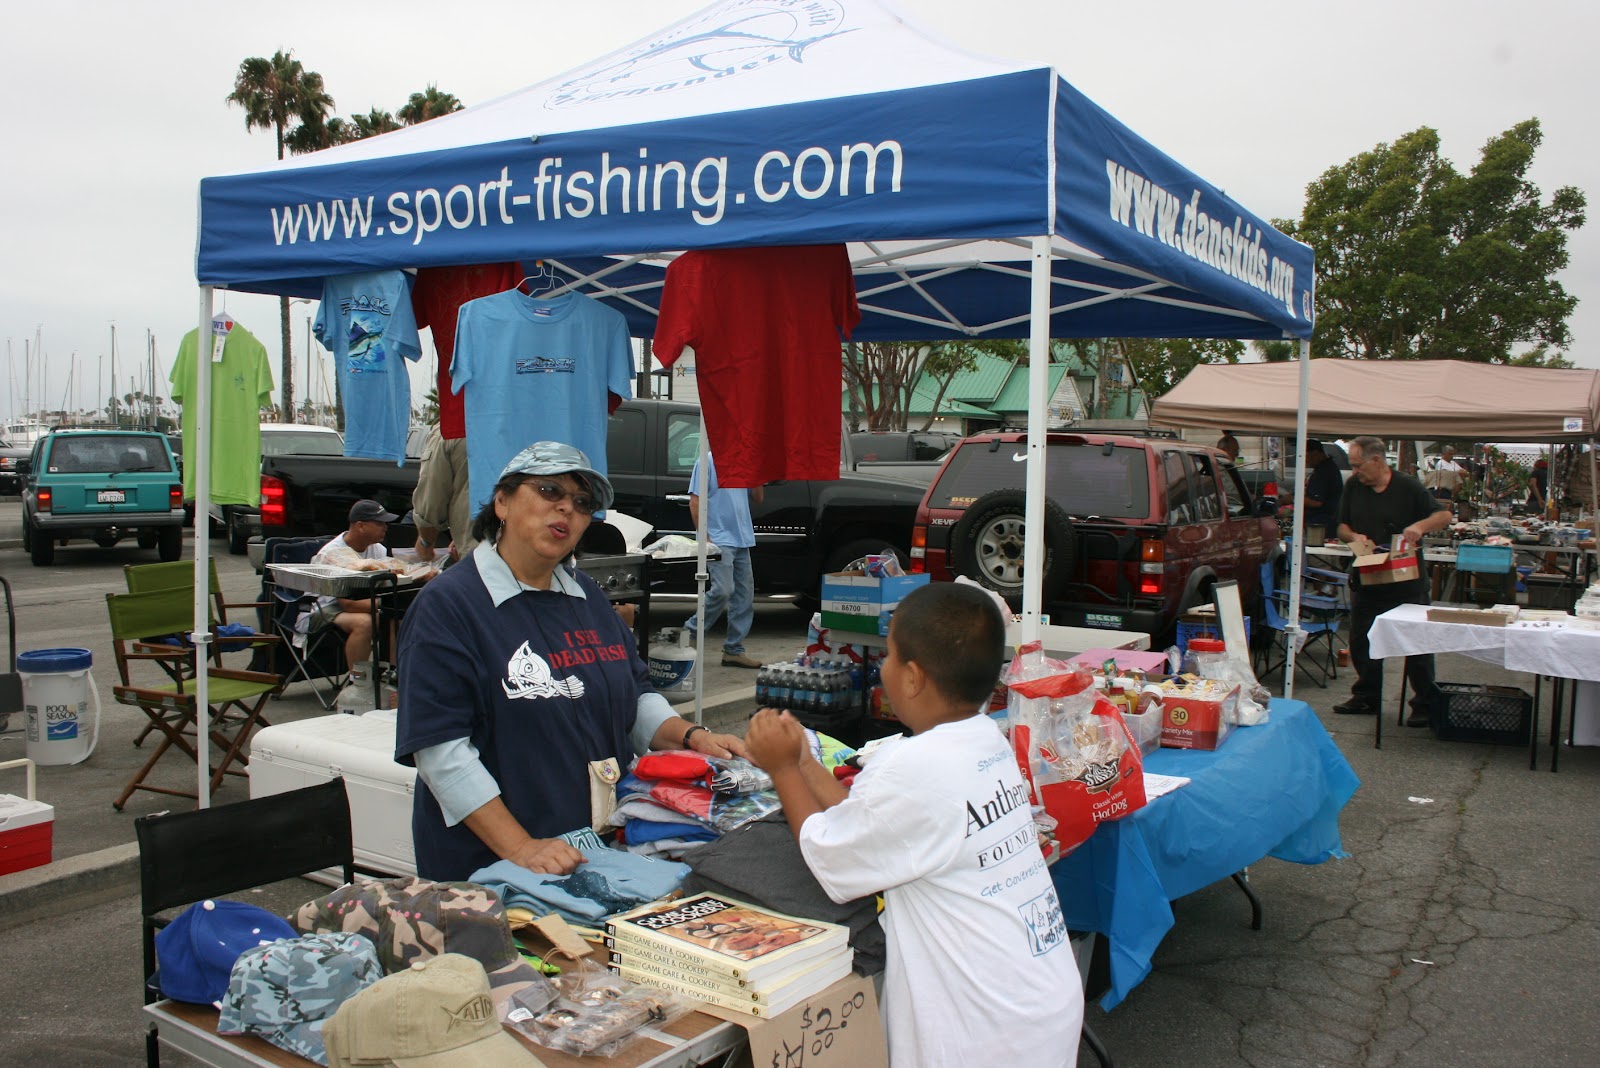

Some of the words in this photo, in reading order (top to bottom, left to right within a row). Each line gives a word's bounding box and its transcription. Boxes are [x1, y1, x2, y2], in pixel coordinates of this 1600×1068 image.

[271, 139, 904, 247] www.sport-fishing.com
[1106, 159, 1297, 319] www.danskids.org
[841, 604, 861, 612] 86700
[563, 631, 574, 648] I
[574, 629, 602, 647] SEE
[547, 648, 597, 669] DEAD
[650, 660, 672, 671] Blue
[46, 704, 69, 713] POOL
[46, 711, 77, 720] SEASON
[1173, 710, 1186, 720] 30
[1161, 726, 1182, 736] Variety
[1182, 728, 1194, 736] Mix
[1092, 808, 1111, 822] Hot
[1111, 798, 1128, 814] Dog
[980, 881, 1002, 898] Get
[637, 910, 680, 927] GAME
[681, 899, 720, 914] CARE
[661, 901, 728, 926] COOKERY
[633, 935, 652, 947] GAME
[652, 941, 668, 953] CARE
[669, 947, 674, 955] &
[675, 950, 705, 966] COOKERY
[634, 948, 653, 960] GAME
[653, 954, 670, 965] CARE
[671, 959, 677, 967] &
[678, 961, 710, 976] COOKERY
[641, 962, 661, 974] GAME
[662, 968, 679, 979] CARE
[681, 973, 687, 981] &
[688, 975, 721, 991] COOKERY
[640, 976, 660, 988] GAME
[661, 982, 679, 992] CARE
[680, 987, 686, 995] &
[688, 989, 721, 1004] COOKERY
[800, 991, 865, 1036] $2.00
